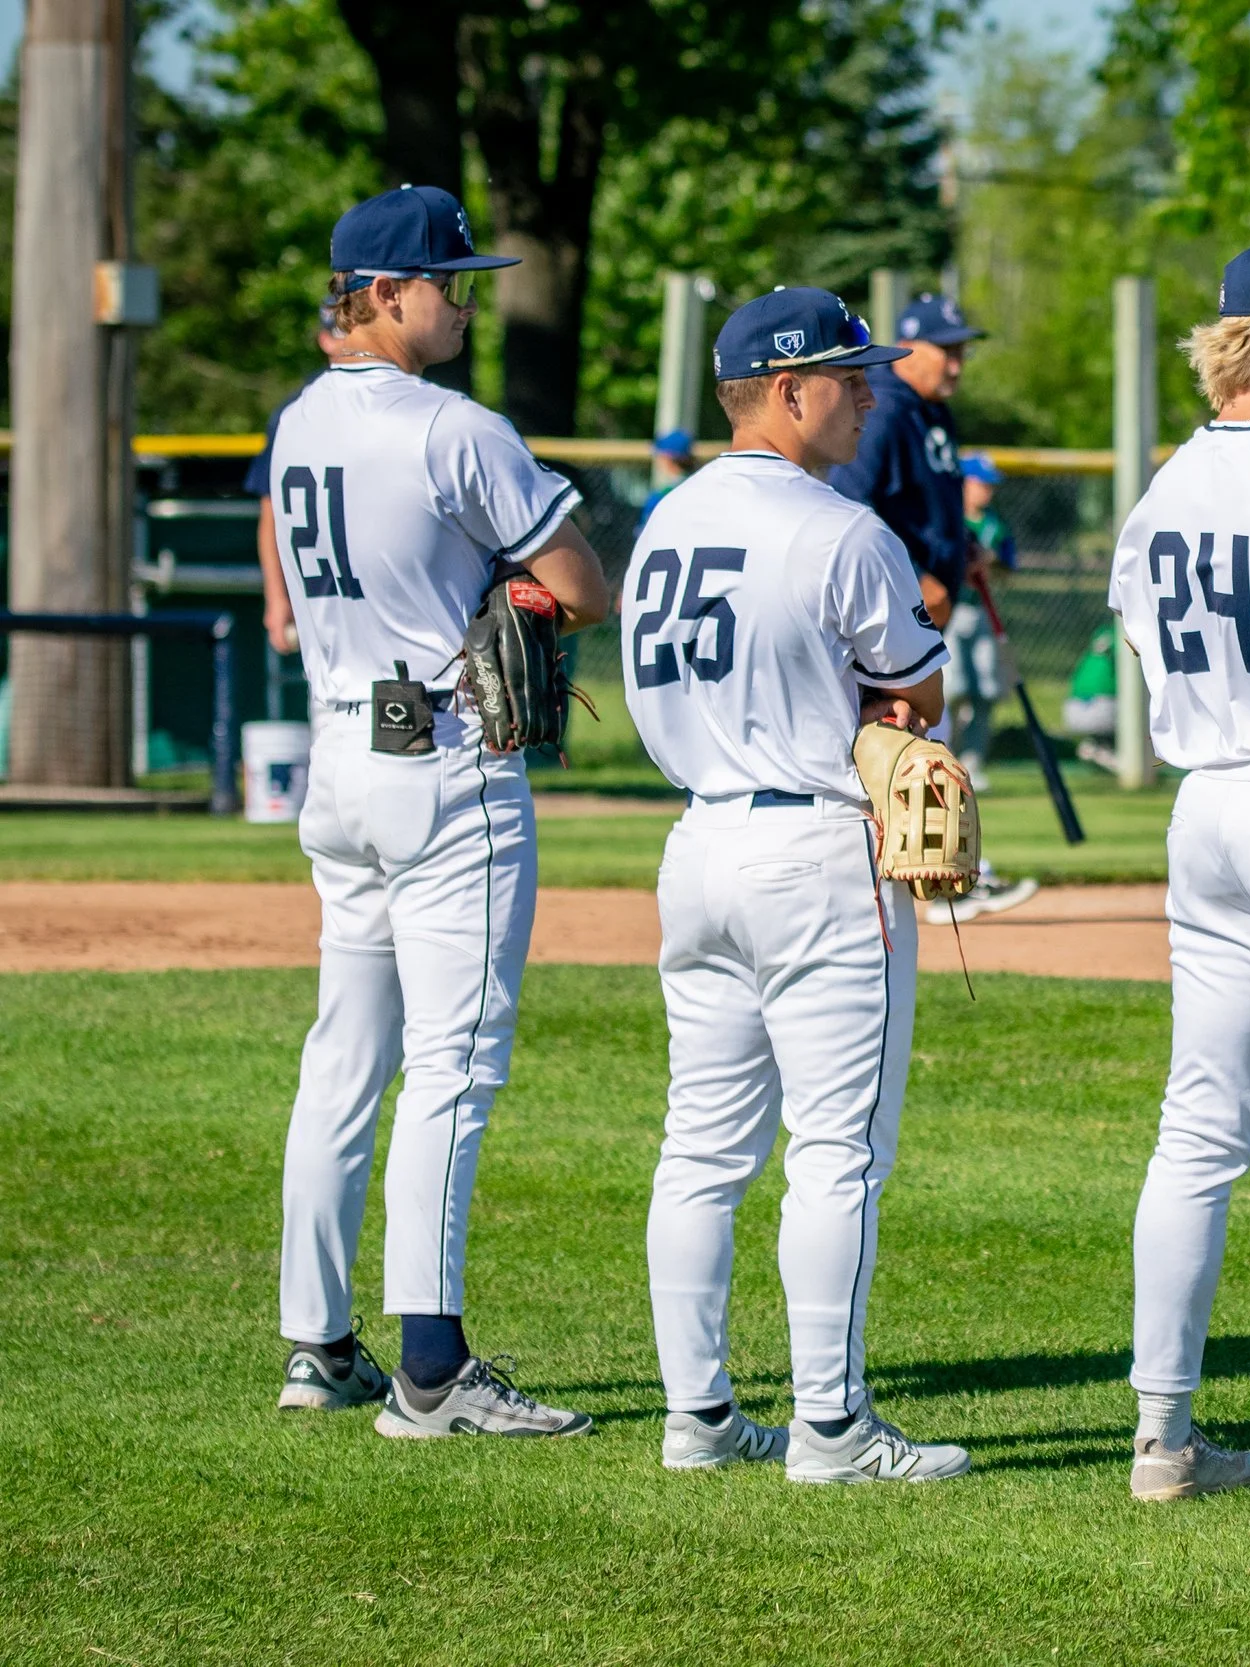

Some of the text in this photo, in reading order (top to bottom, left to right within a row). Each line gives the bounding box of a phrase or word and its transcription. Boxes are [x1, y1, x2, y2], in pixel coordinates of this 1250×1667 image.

[282, 467, 364, 599] 21
[473, 655, 500, 714] Rawlings
[634, 548, 746, 689] 25
